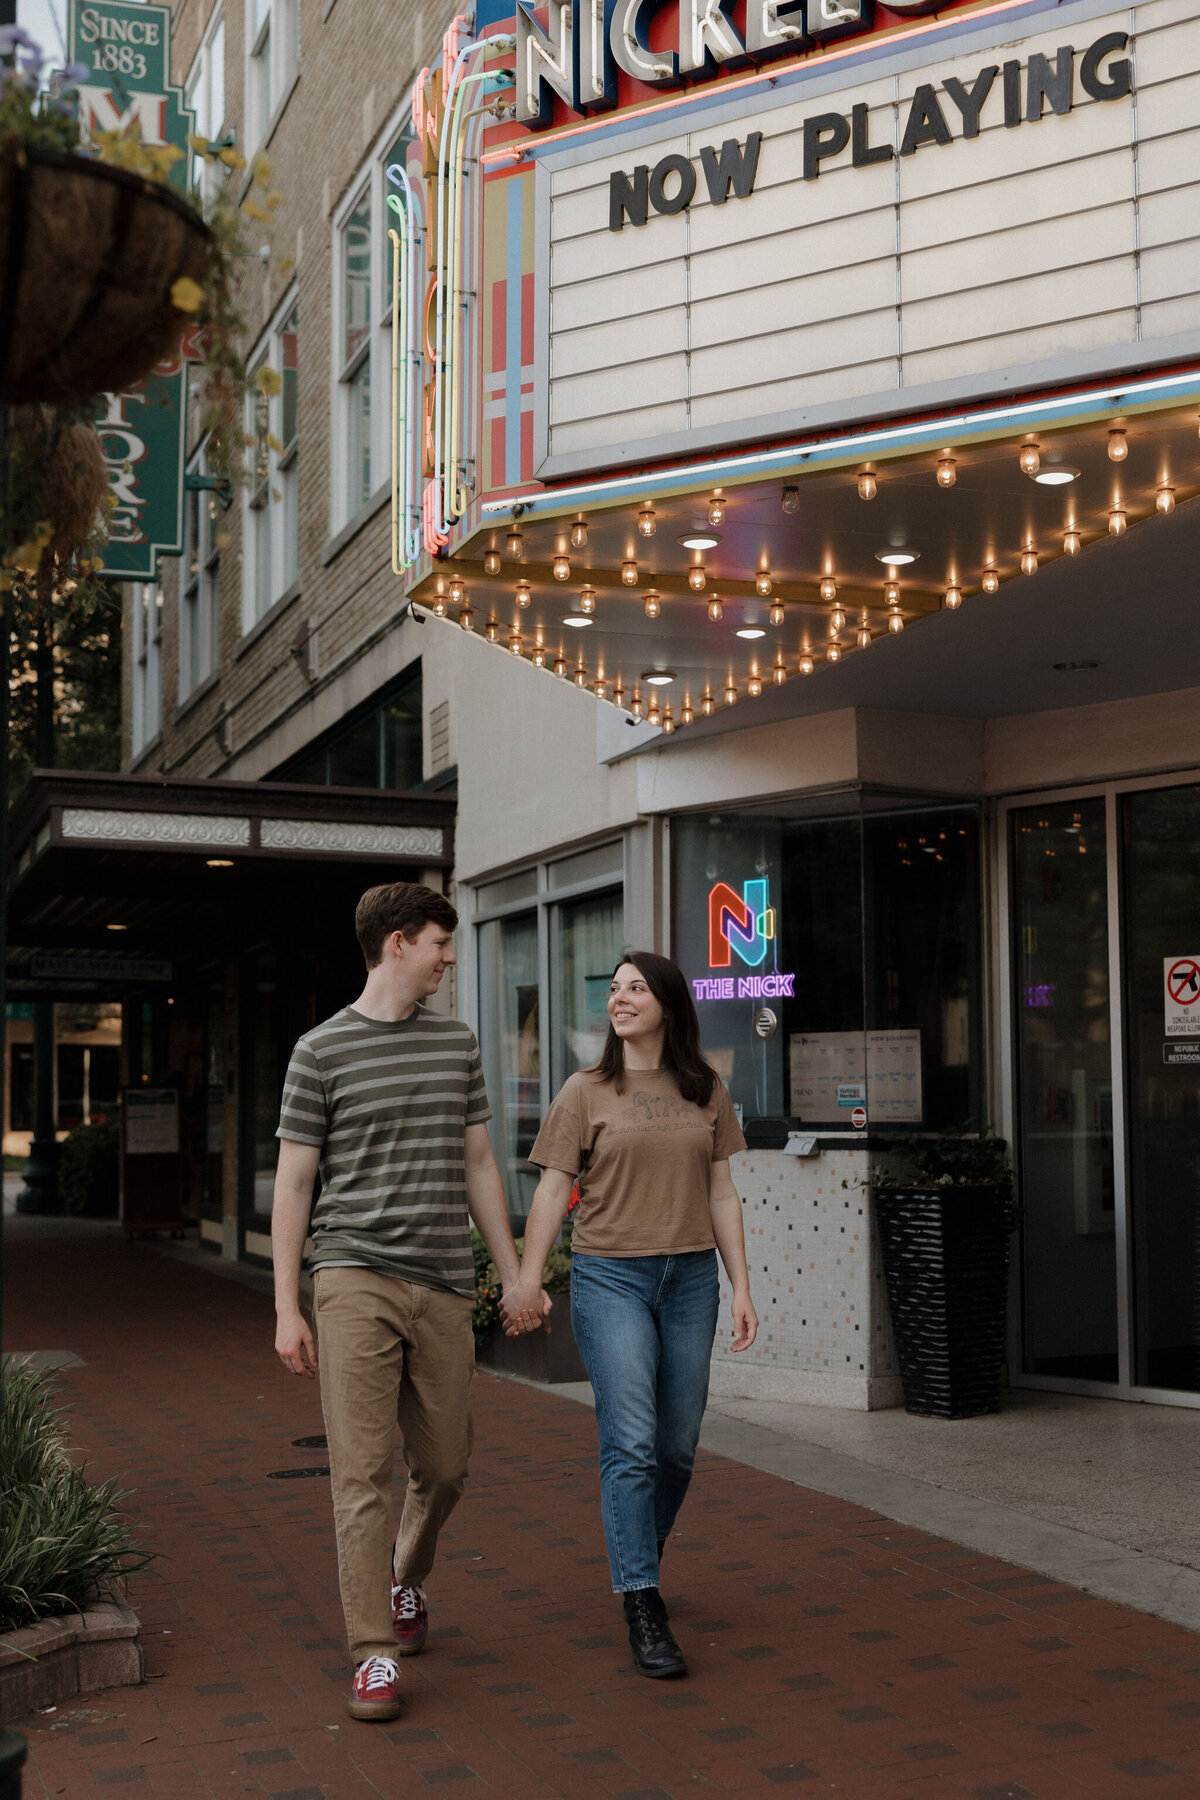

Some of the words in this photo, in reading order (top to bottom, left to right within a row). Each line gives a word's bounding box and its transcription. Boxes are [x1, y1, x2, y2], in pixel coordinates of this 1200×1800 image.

[80, 8, 159, 46] SINCE
[92, 44, 147, 79] 1883
[515, 0, 961, 129] NICK
[608, 130, 763, 232] NOW
[802, 31, 1132, 182] PLAYING
[692, 977, 734, 1000] THE
[738, 973, 793, 998] NICK
